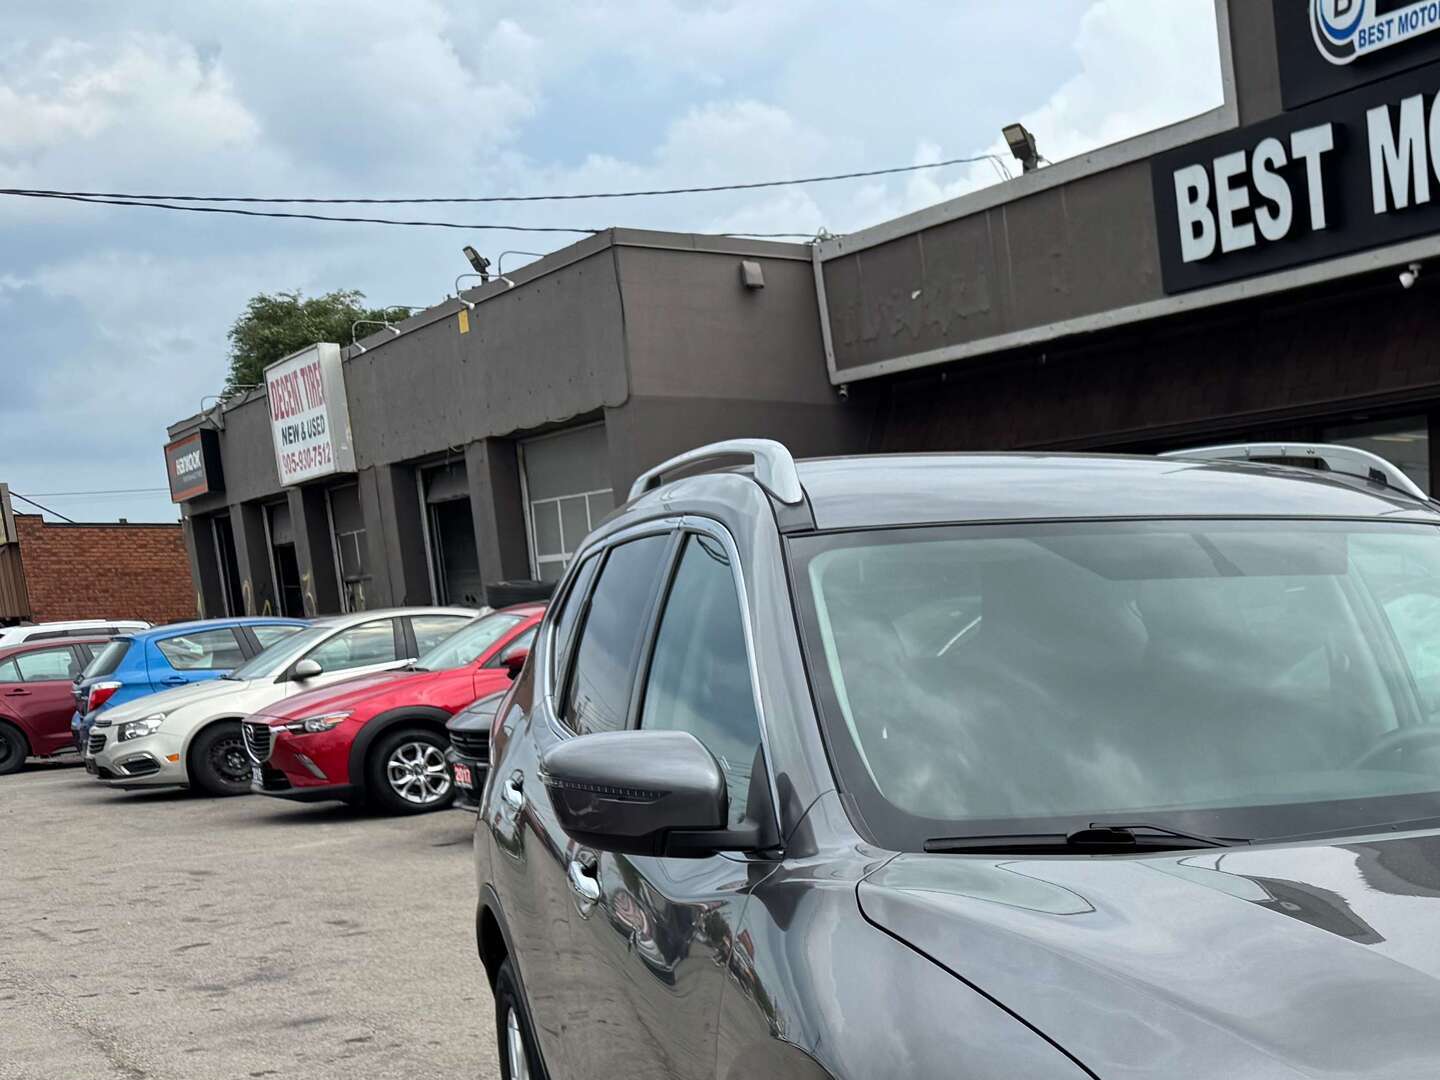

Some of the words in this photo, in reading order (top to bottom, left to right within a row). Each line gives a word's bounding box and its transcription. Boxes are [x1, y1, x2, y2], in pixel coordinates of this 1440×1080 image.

[1359, 19, 1393, 49] BEST
[1174, 123, 1334, 264] BEST
[271, 370, 304, 421] DECENT
[282, 425, 300, 446] NEW
[301, 421, 306, 441] &
[307, 415, 325, 439] USED
